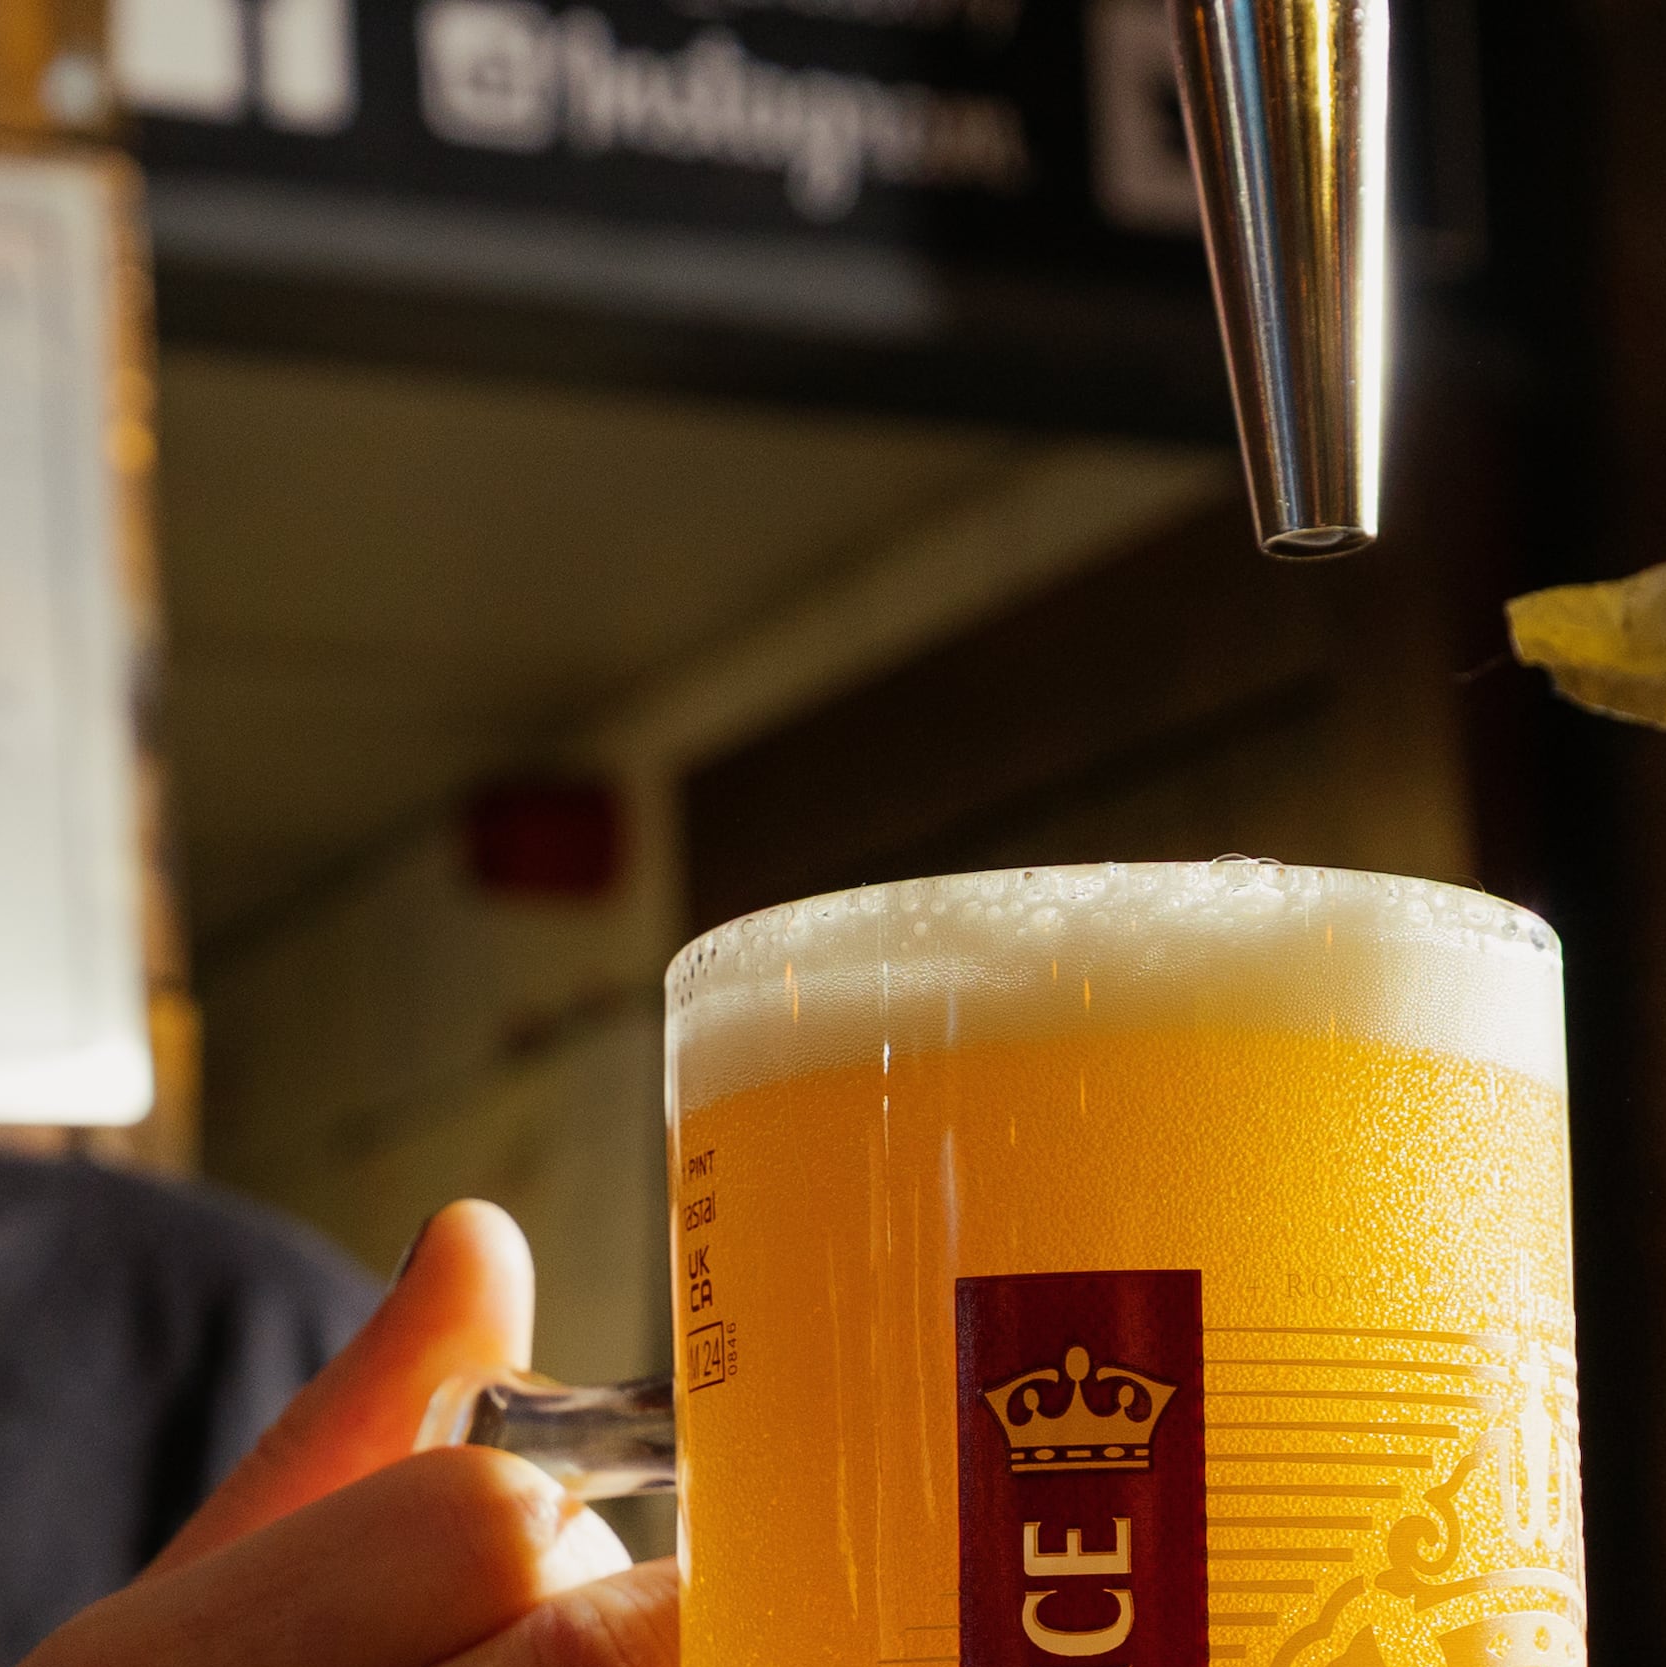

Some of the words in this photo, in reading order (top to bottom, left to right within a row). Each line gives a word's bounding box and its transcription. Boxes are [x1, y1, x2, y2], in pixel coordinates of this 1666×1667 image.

[689, 1148, 716, 1182] PINT
[688, 1245, 710, 1280] UK
[690, 1279, 713, 1313] CA
